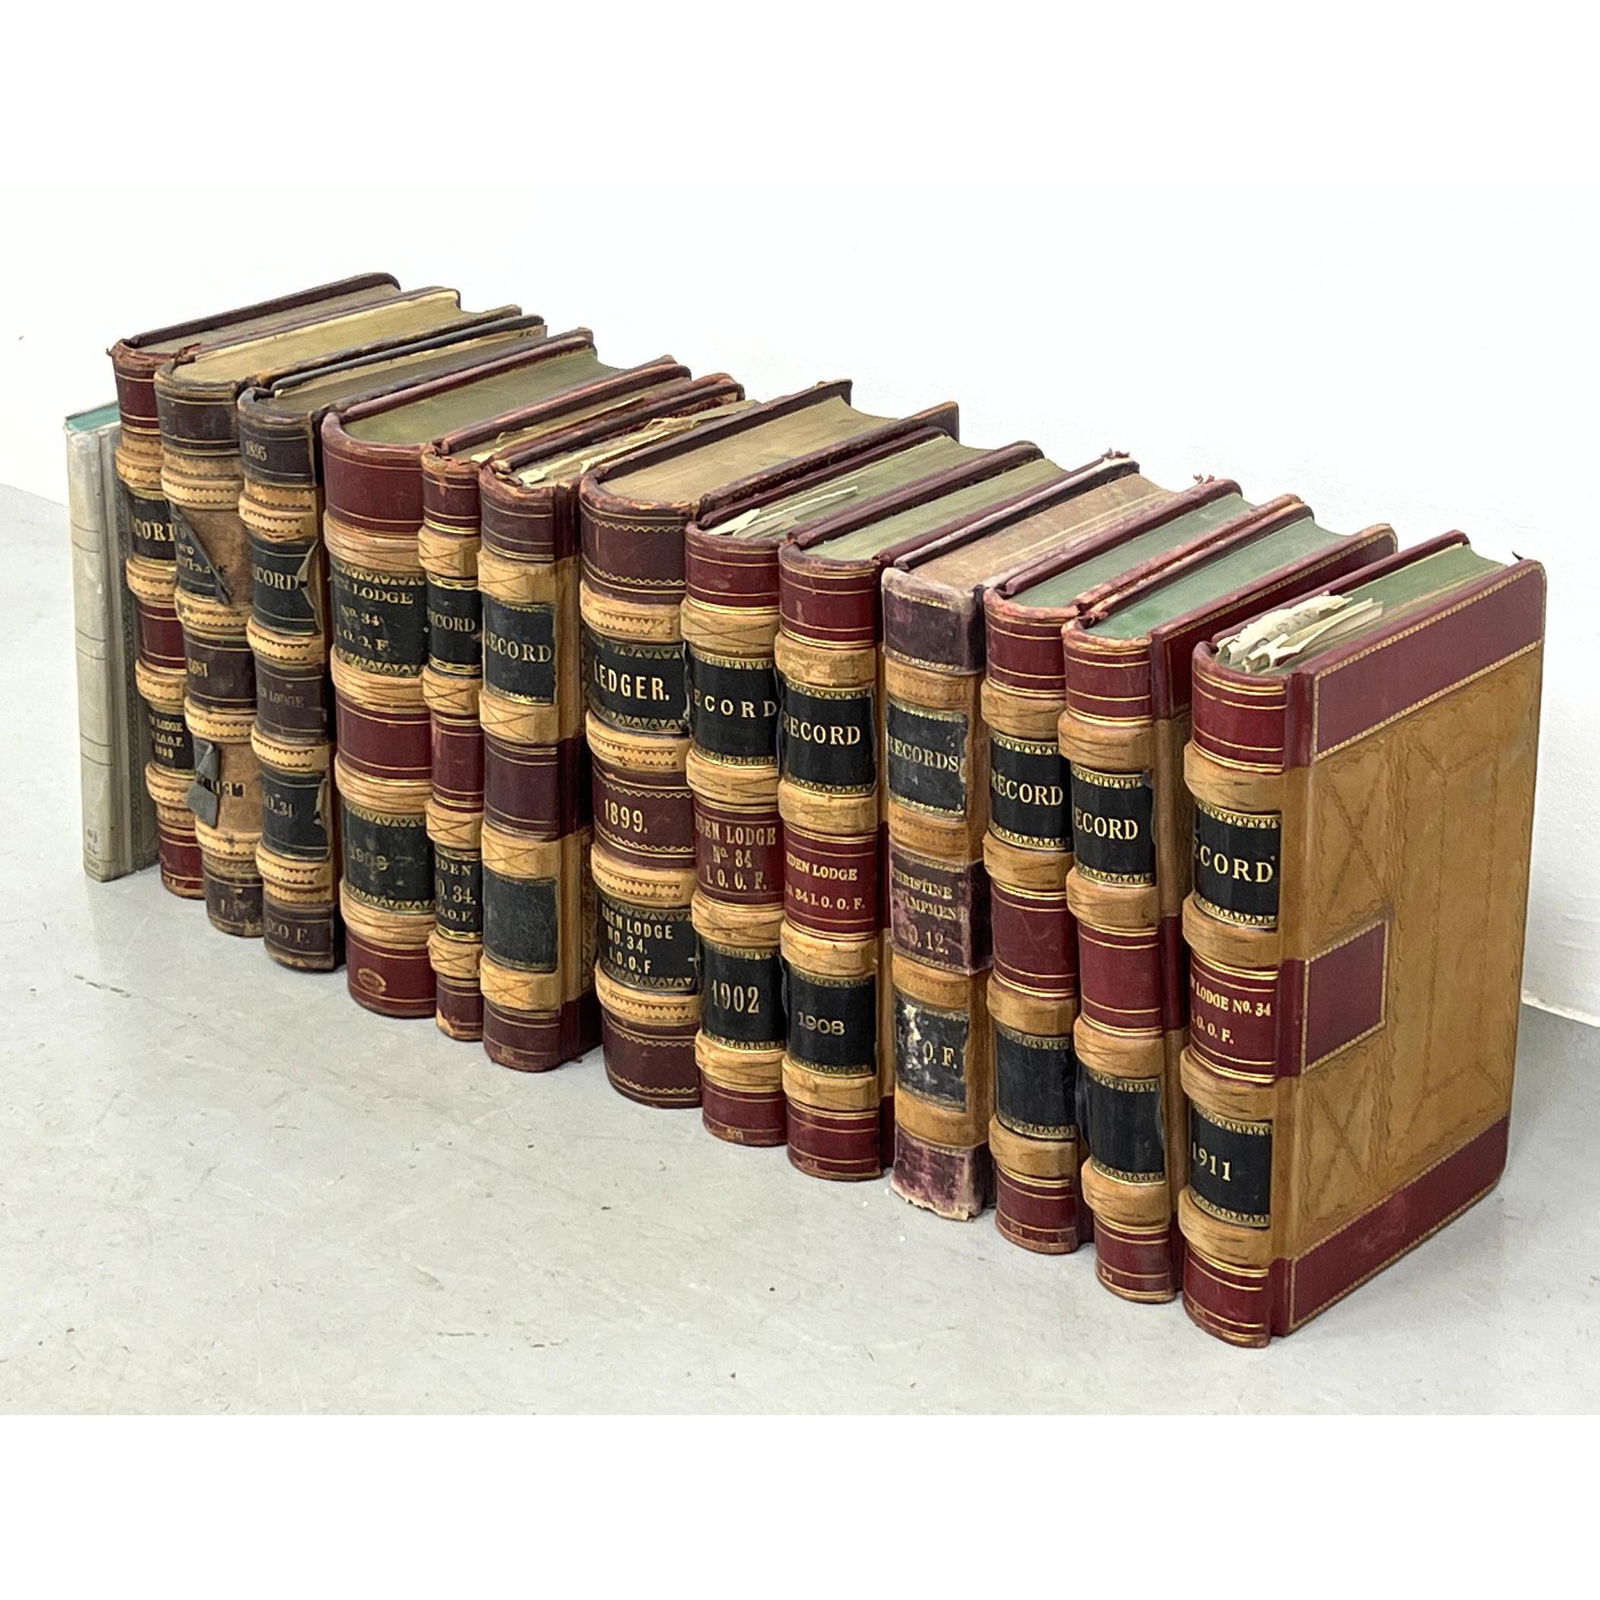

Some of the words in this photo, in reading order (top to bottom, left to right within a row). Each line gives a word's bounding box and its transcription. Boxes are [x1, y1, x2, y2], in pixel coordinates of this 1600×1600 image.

[604, 798, 648, 835] 1899.
[1074, 806, 1139, 840] ECORD
[726, 824, 776, 846] LODGE
[812, 864, 858, 881] LODGE
[626, 918, 674, 940] LODGE
[711, 979, 760, 1014] 1902
[1195, 981, 1229, 1012] LODGE
[798, 1012, 845, 1036] 1908
[1193, 1141, 1232, 1182] 1911
